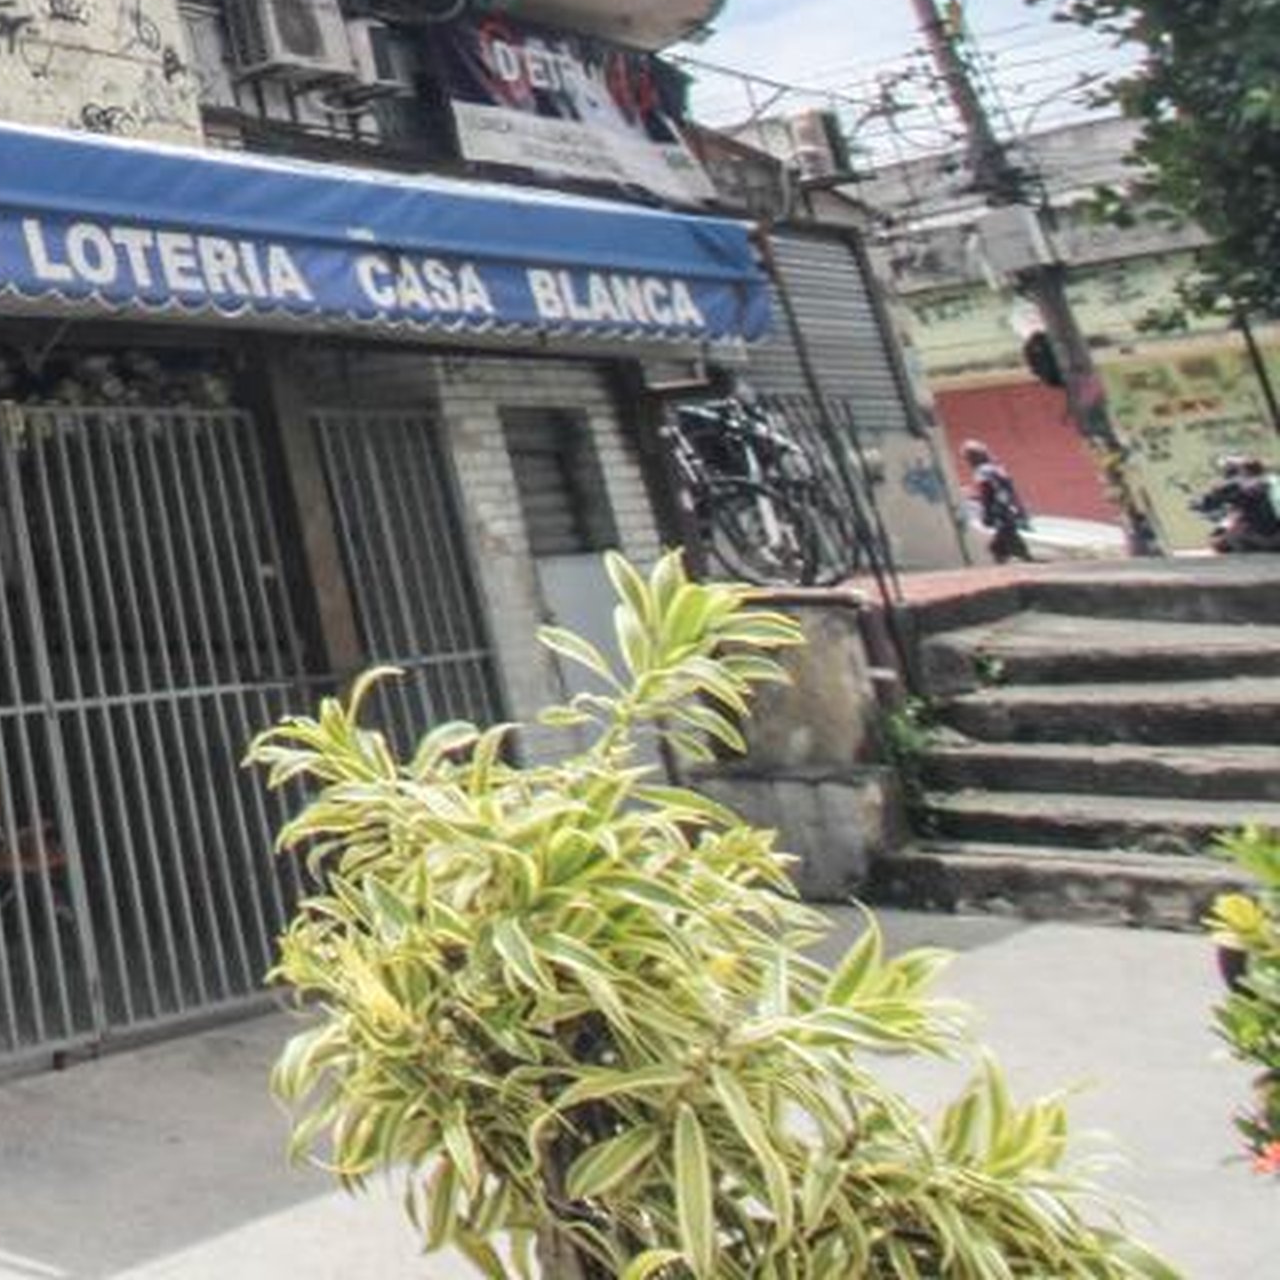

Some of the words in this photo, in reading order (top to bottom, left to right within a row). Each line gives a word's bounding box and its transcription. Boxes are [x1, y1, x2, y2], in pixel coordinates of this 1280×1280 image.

[22, 217, 316, 302] LOTERIA
[353, 253, 496, 316] CASA
[526, 267, 707, 328] BLANCA
